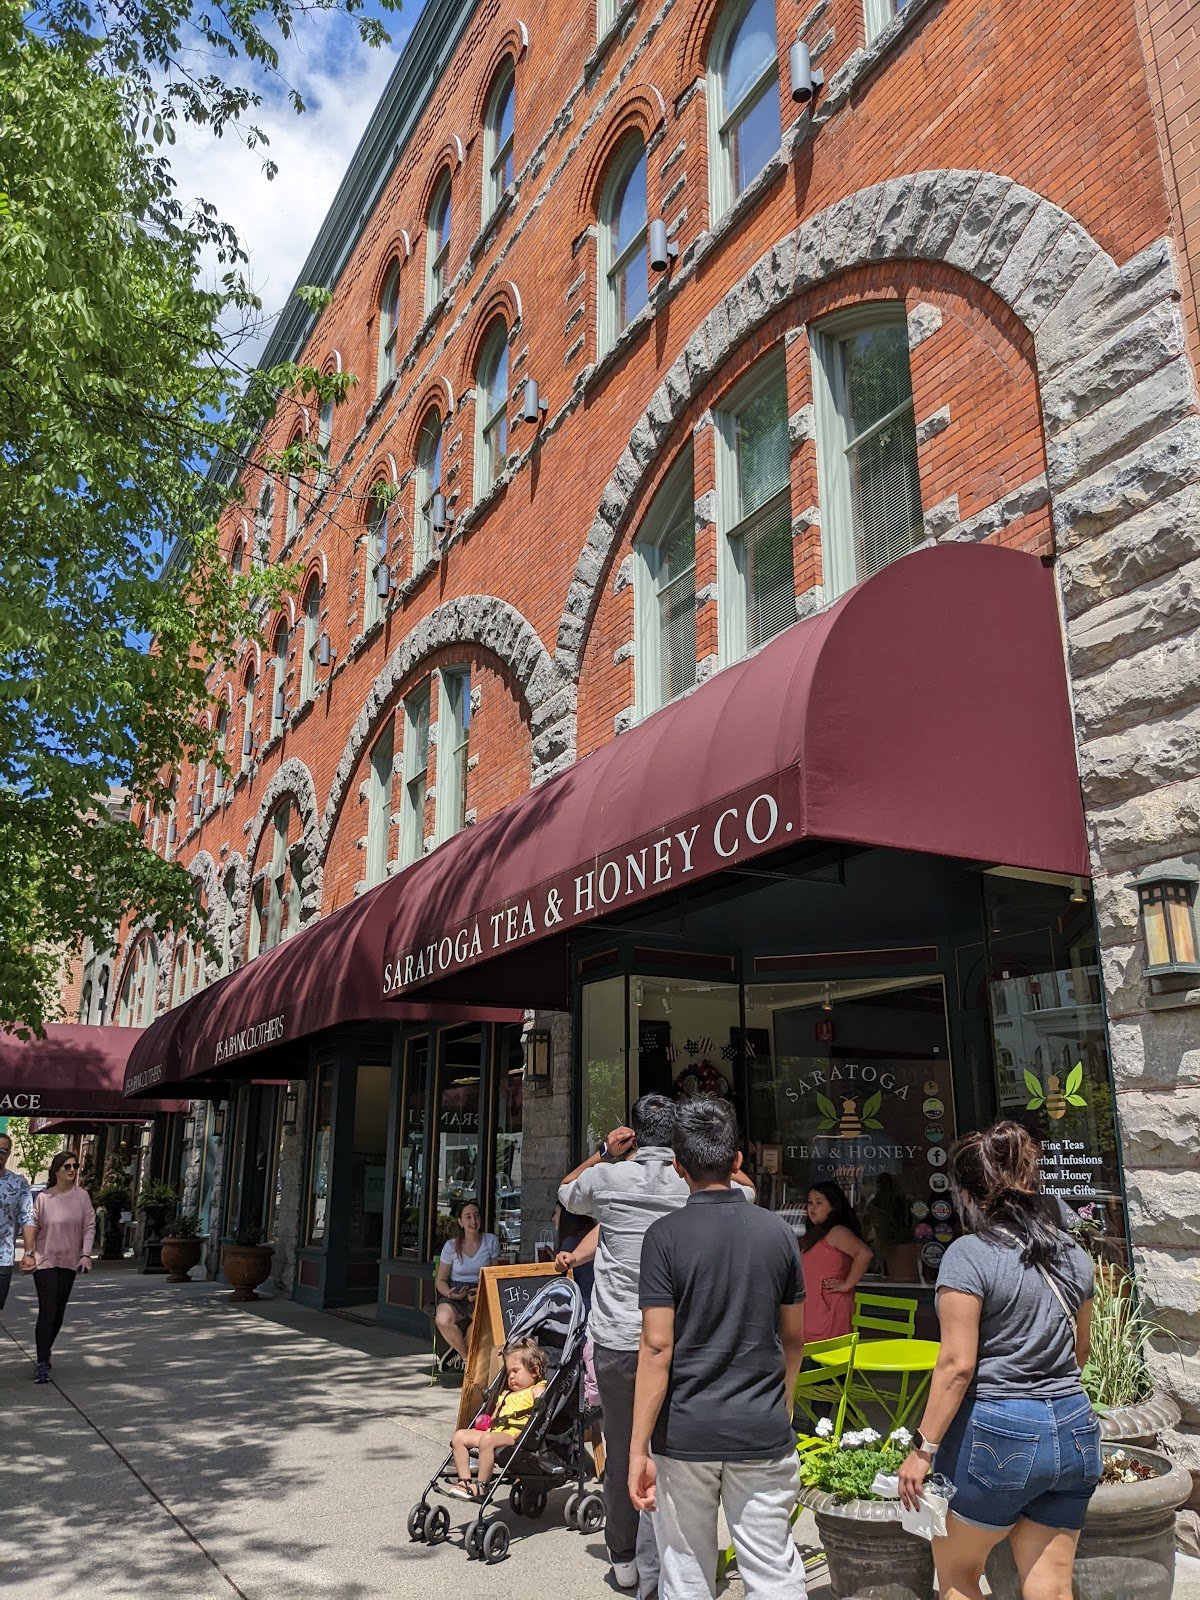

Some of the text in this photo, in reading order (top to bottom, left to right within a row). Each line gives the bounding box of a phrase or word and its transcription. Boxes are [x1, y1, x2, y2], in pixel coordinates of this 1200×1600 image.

[382, 793, 794, 994] SARATOGA TEA & HONEY CO.
[785, 1063, 911, 1104] SARATOGA
[1040, 1139, 1084, 1150] Fine Teas
[787, 1145, 918, 1159] TEA & HONEY
[1036, 1154, 1103, 1165] erbal Infusions
[1039, 1169, 1092, 1182] Raw Honey
[1039, 1184, 1096, 1197] Unique Gifts
[504, 1285, 530, 1303] It's
